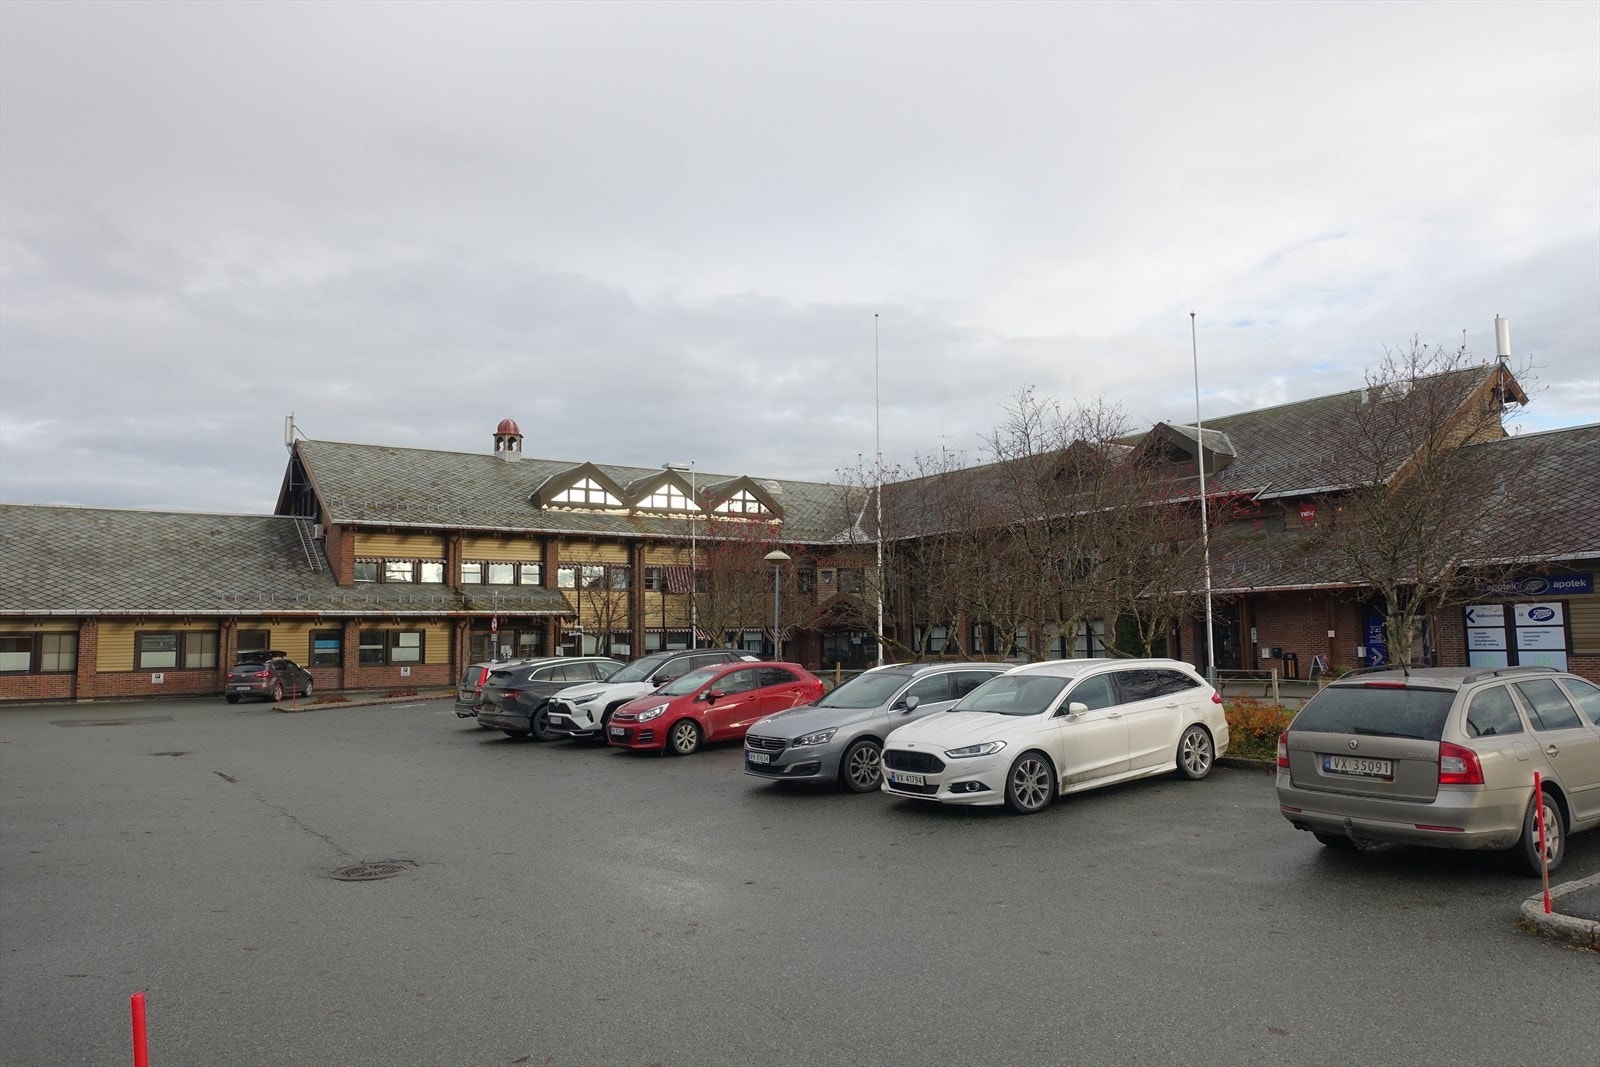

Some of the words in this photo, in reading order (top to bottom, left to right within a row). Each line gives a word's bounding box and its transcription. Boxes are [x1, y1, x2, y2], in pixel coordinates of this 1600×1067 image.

[1553, 579, 1586, 589] apotek
[1334, 757, 1350, 769] VX
[1353, 760, 1389, 773] 35091
[896, 773, 904, 781] VX
[905, 775, 922, 784] 41794
